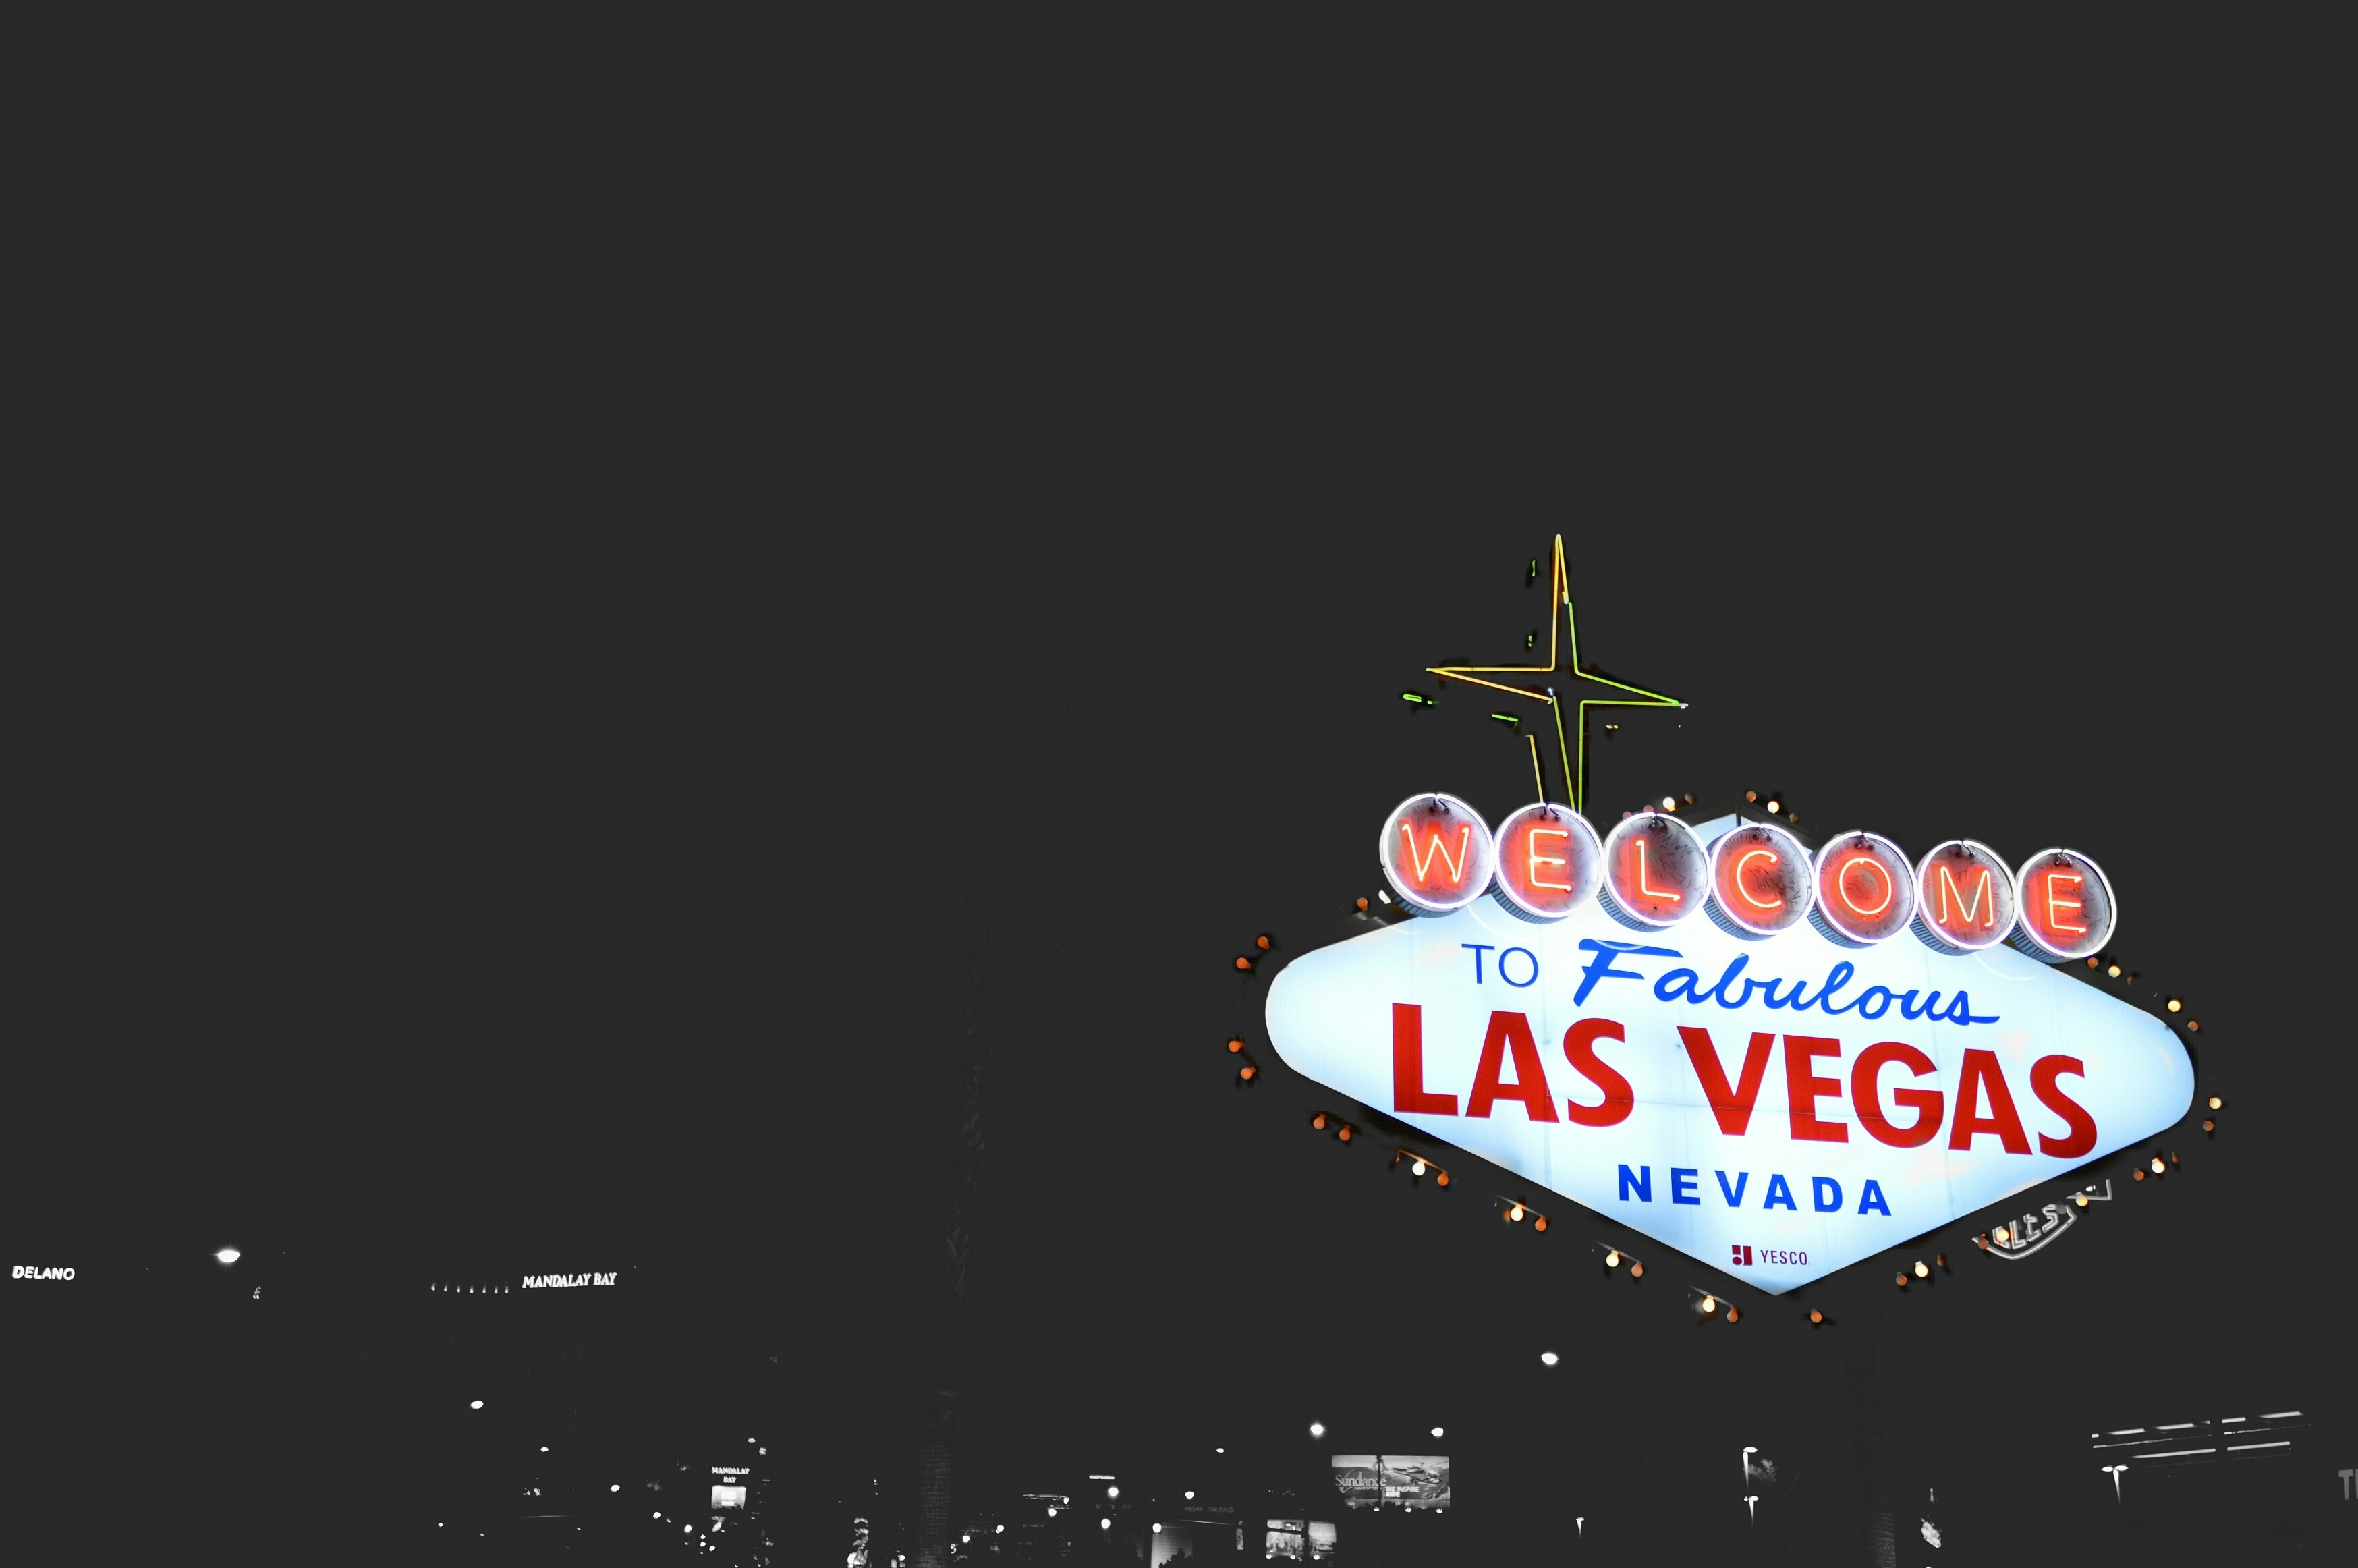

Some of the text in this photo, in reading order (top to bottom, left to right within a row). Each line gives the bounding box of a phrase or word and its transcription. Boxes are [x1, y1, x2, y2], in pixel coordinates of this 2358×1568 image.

[1400, 821, 2088, 935] WELCOME
[1461, 938, 2001, 1026] TO Fabulous
[1392, 1003, 2098, 1158] LAS VEGAS
[1617, 1163, 1892, 1217] NEVADA
[1760, 1250, 1808, 1266] YESCO
[11, 1265, 76, 1281] DELANO
[522, 1271, 618, 1289] MANDALAY BAY
[711, 1466, 751, 1475] MANDALAY
[723, 1476, 737, 1484] BAY
